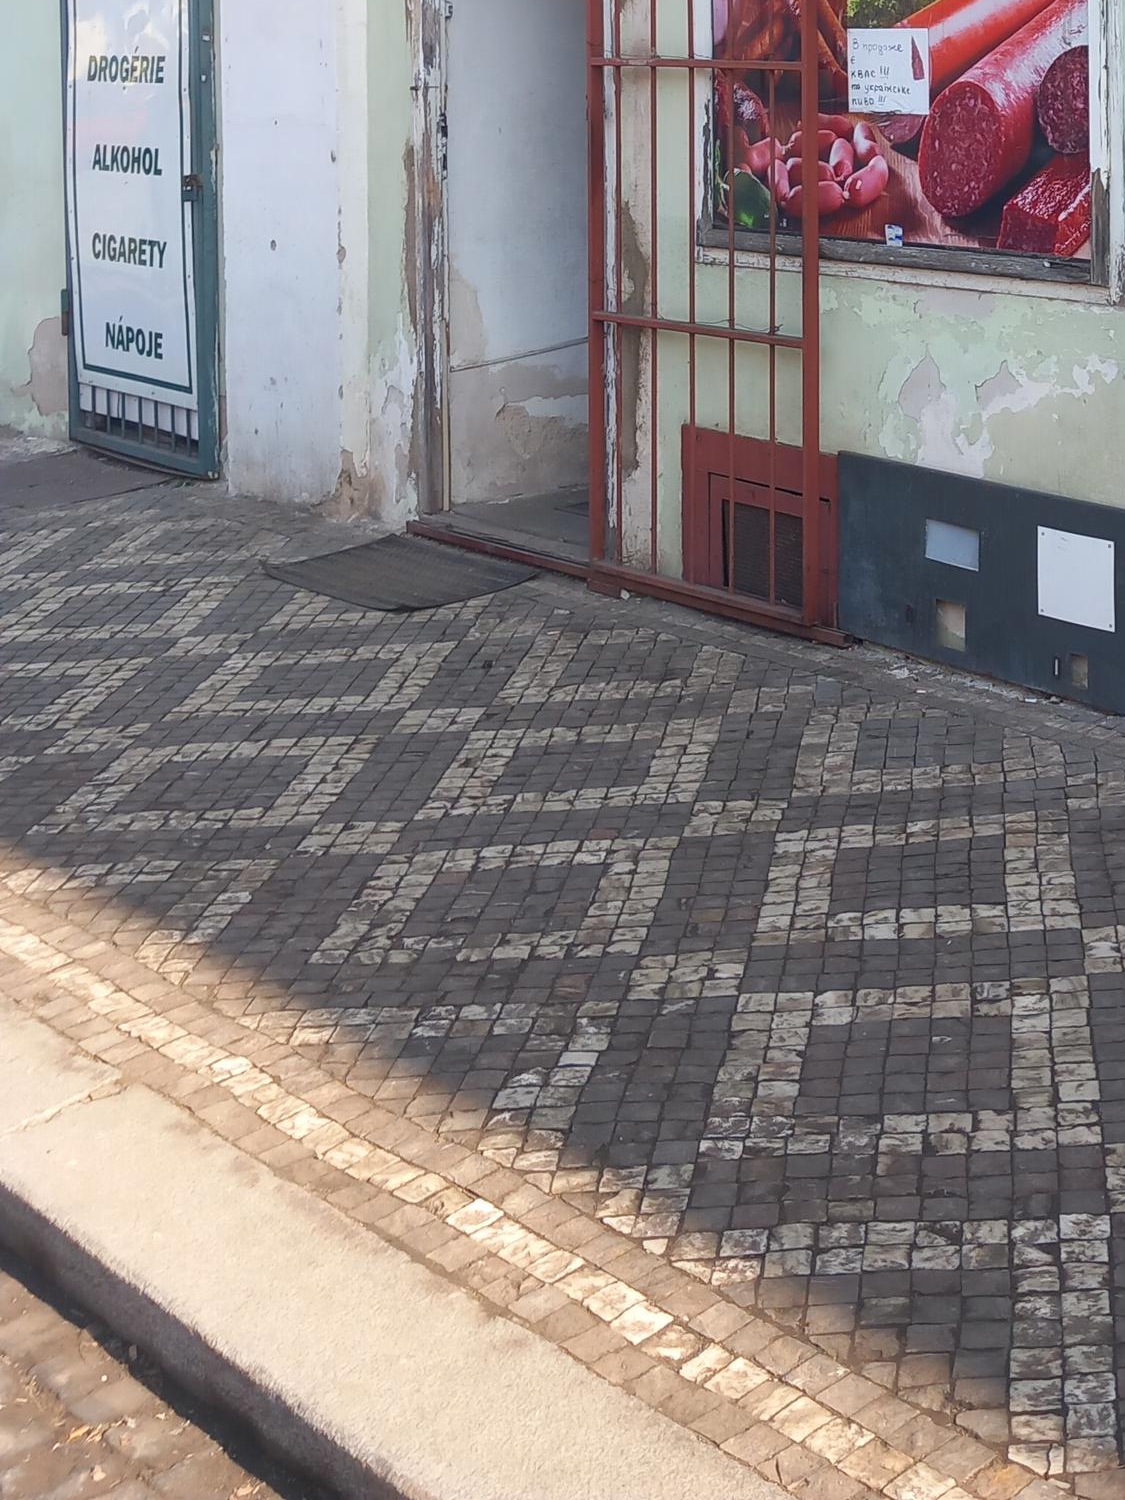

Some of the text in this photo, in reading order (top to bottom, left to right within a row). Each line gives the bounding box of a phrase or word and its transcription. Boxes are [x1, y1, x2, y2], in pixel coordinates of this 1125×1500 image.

[87, 45, 166, 84] DROGÉRIE
[92, 144, 163, 176] ALKOHOL
[92, 232, 167, 269] CIGARETY
[105, 316, 163, 360] NÁPOJE
